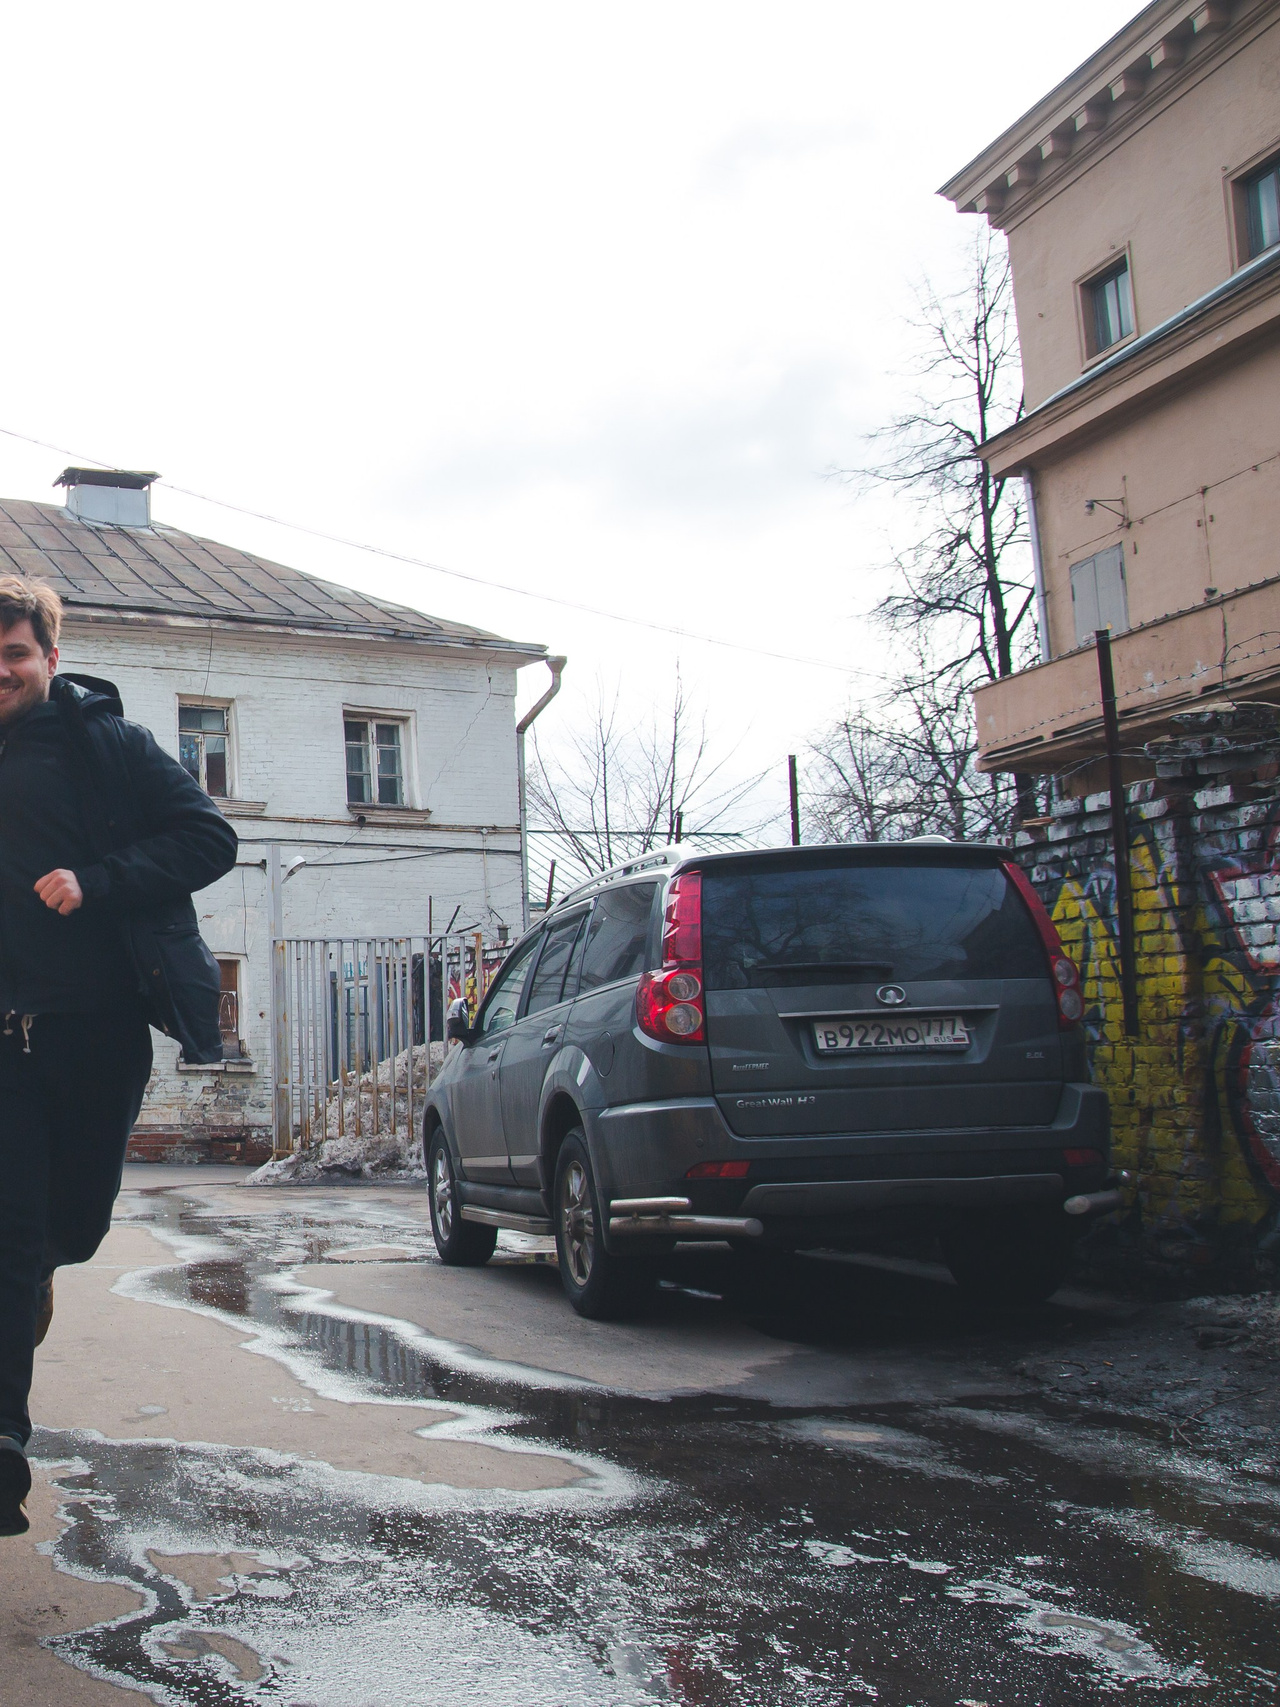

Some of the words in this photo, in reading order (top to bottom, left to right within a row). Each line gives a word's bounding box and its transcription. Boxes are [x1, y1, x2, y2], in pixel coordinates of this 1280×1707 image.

[823, 1023, 920, 1048] В922МО
[920, 1017, 957, 1037] 777
[933, 1036, 953, 1044] RUS
[736, 1099, 767, 1109] Great
[767, 1097, 793, 1107] Wall
[797, 1095, 816, 1105] H3
